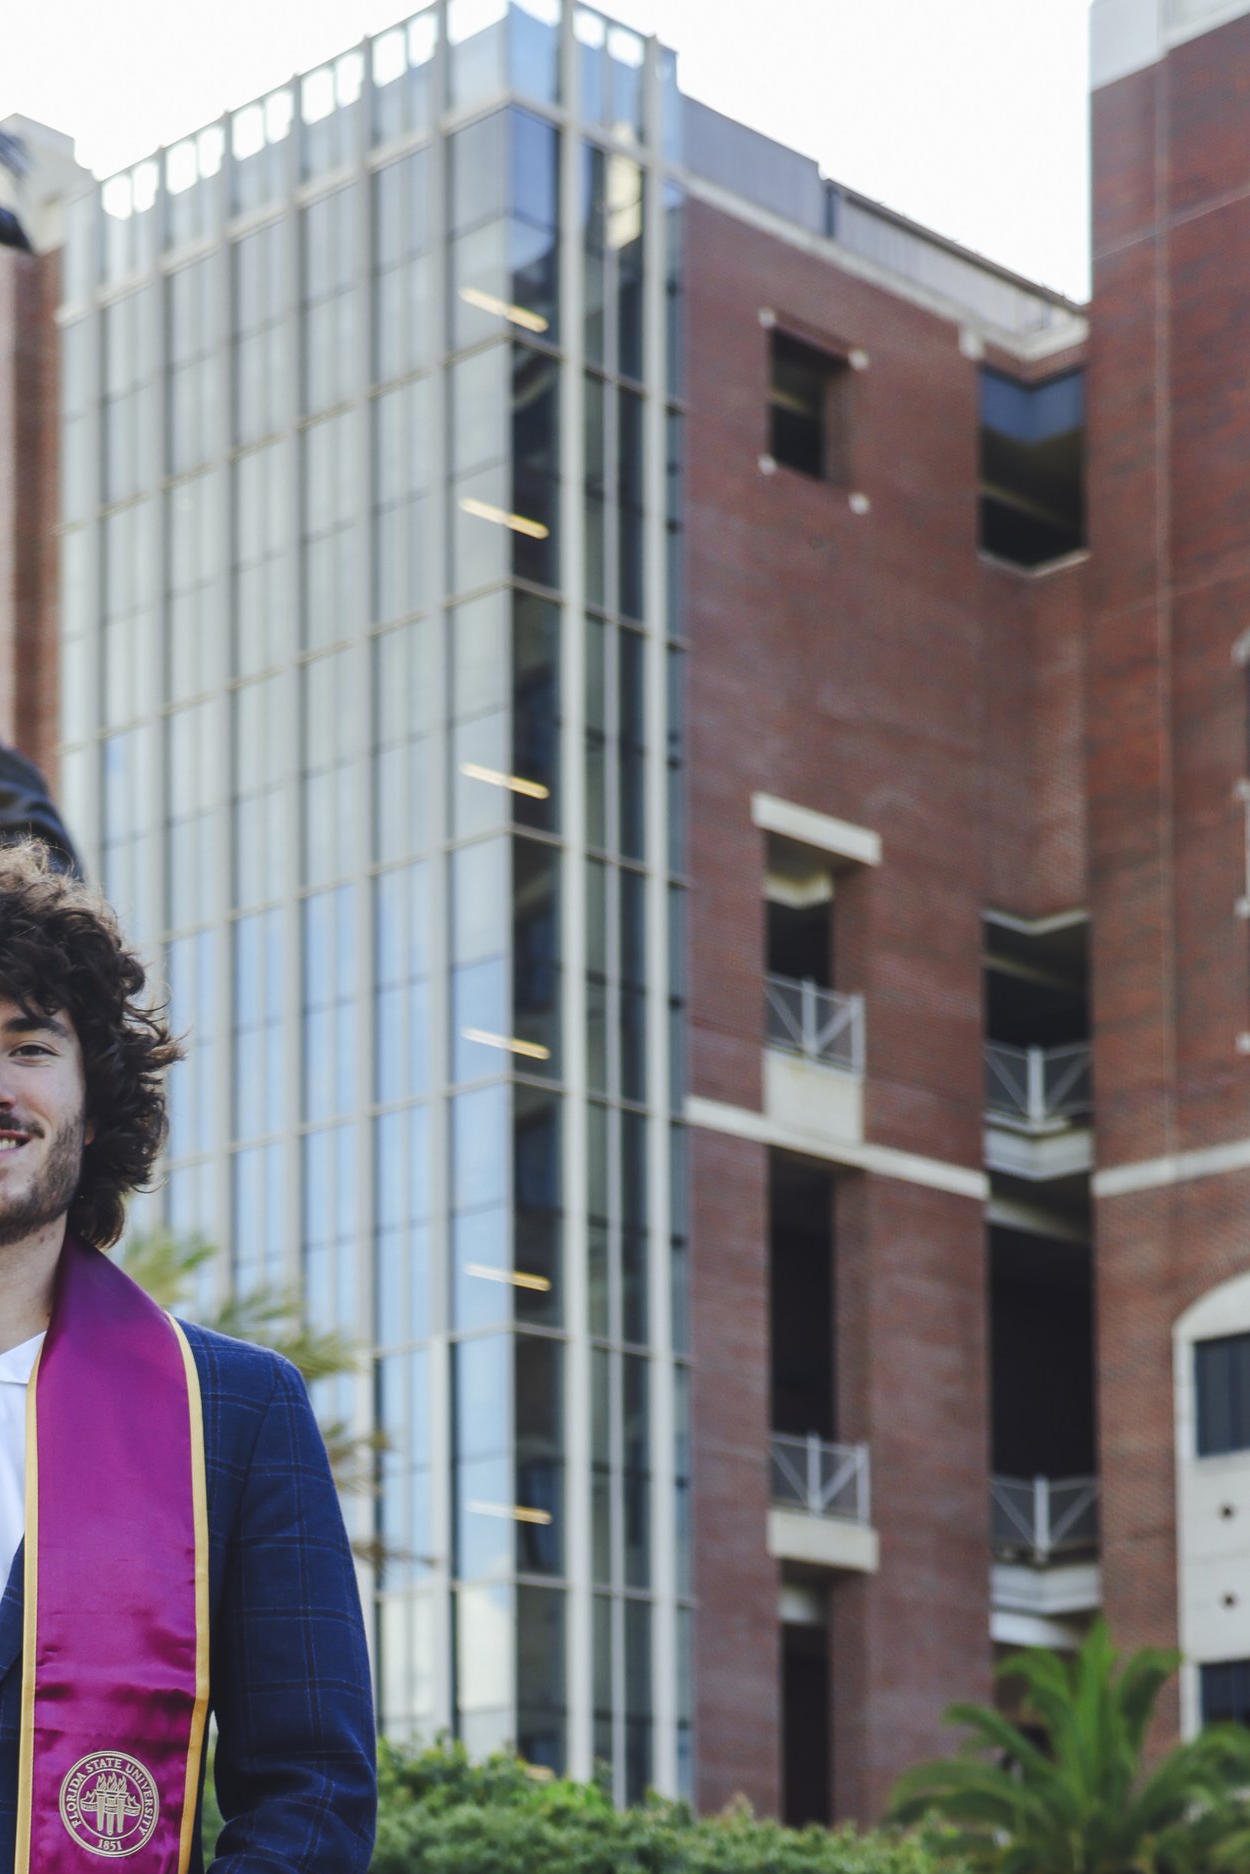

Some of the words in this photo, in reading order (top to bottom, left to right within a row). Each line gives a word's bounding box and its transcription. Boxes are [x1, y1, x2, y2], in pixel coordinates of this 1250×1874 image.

[66, 1772, 87, 1828] FLORIDA
[85, 1757, 123, 1774] STATE
[125, 1763, 154, 1836] UNIVERSITY
[97, 1839, 123, 1852] 1851
